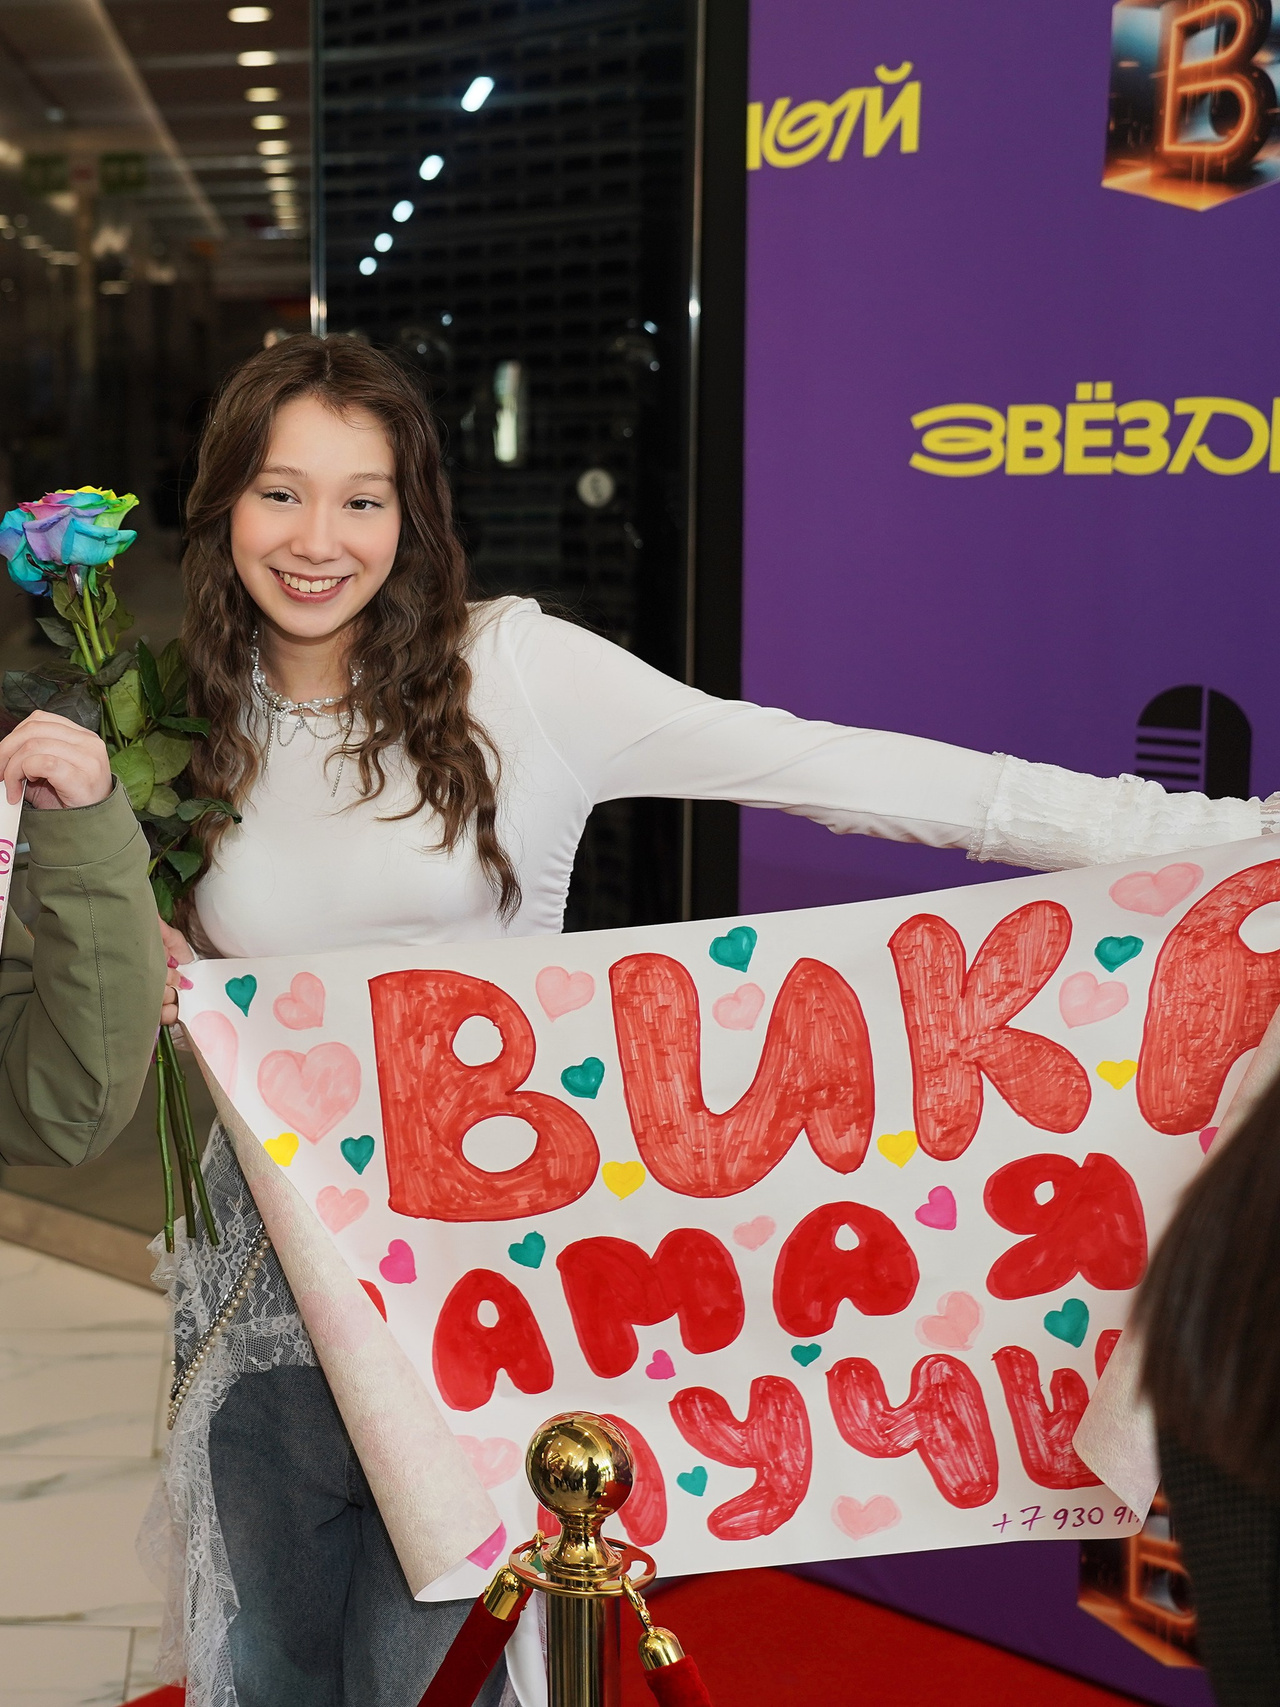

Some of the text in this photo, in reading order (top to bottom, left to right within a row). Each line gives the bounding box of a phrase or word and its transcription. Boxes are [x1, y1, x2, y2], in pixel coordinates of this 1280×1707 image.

[909, 381, 1280, 478] ЗВЁЗД
[358, 1152, 1149, 1412] АМАЯ
[1052, 1506, 1105, 1531] 930
